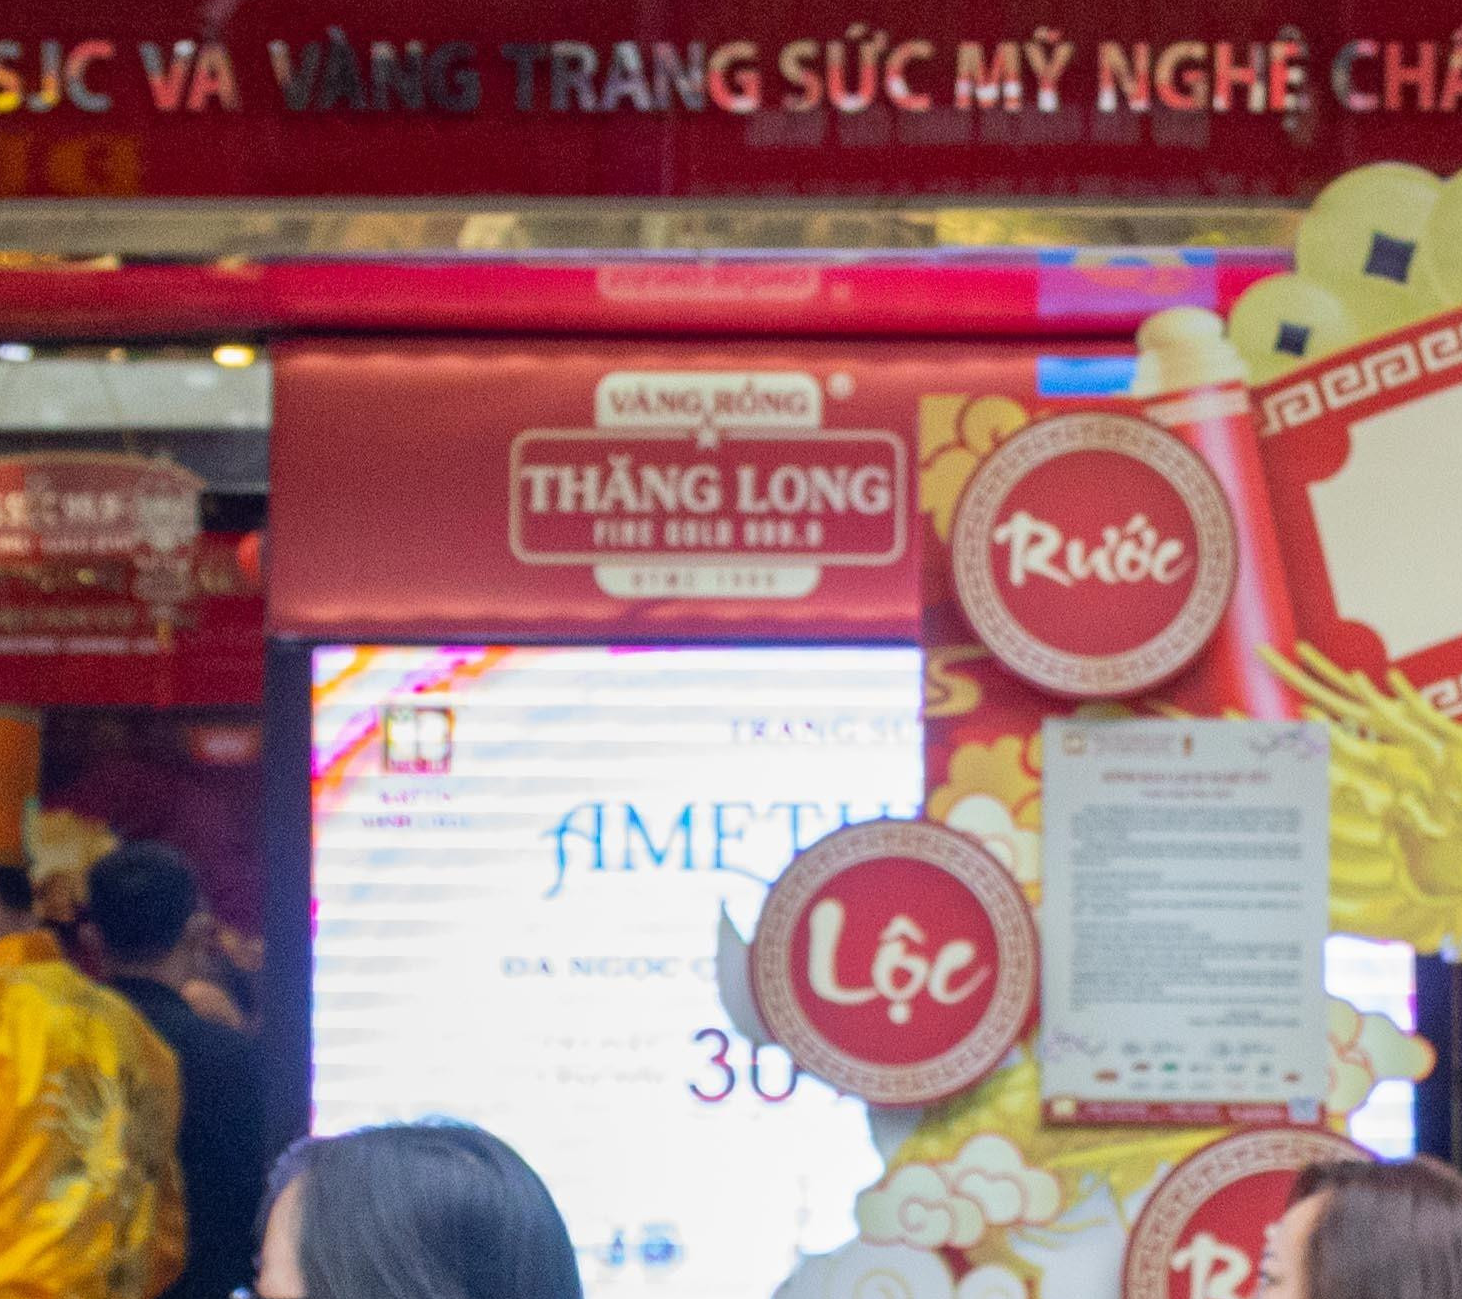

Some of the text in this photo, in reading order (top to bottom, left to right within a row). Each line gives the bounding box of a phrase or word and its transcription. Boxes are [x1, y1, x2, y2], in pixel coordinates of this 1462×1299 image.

[266, 24, 482, 115] VÀNG
[500, 40, 762, 115] TRANG
[778, 22, 934, 114] SỨC
[953, 25, 1076, 113] MỸ
[1097, 25, 1311, 128] NGHỆ
[607, 380, 809, 415] VÀNG RỒNG
[520, 454, 891, 515] THĂNG LONG
[992, 511, 1192, 589] Rước
[808, 898, 992, 1025] Lộc
